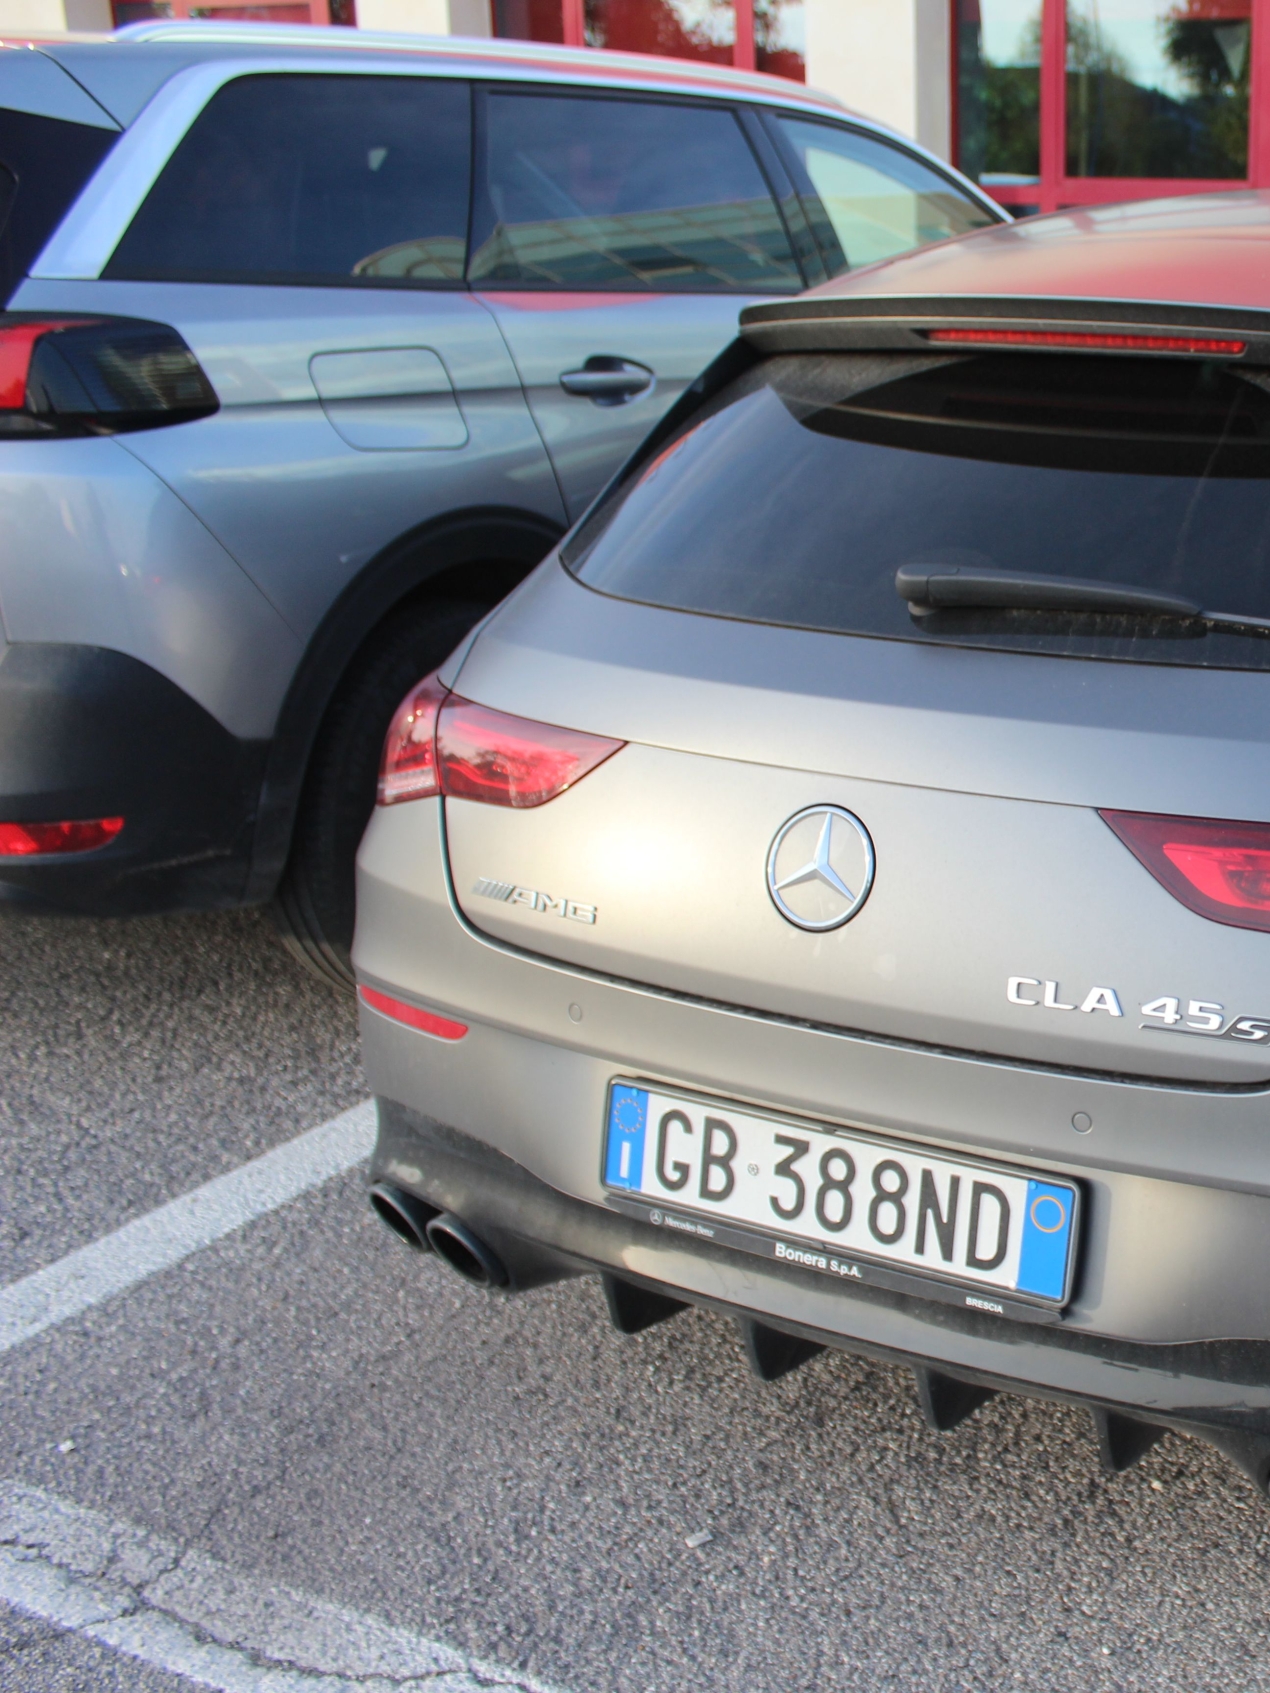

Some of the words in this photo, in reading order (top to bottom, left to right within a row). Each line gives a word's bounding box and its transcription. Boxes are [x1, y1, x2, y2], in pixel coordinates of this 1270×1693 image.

[510, 887, 597, 924] AMG
[1006, 976, 1124, 1018] CLA
[655, 1109, 738, 1202] GB
[769, 1132, 1011, 1271] 388ND
[775, 1242, 826, 1269] Bonera
[829, 1260, 862, 1278] S.p.A.
[965, 1296, 1004, 1314] BRESCIA
